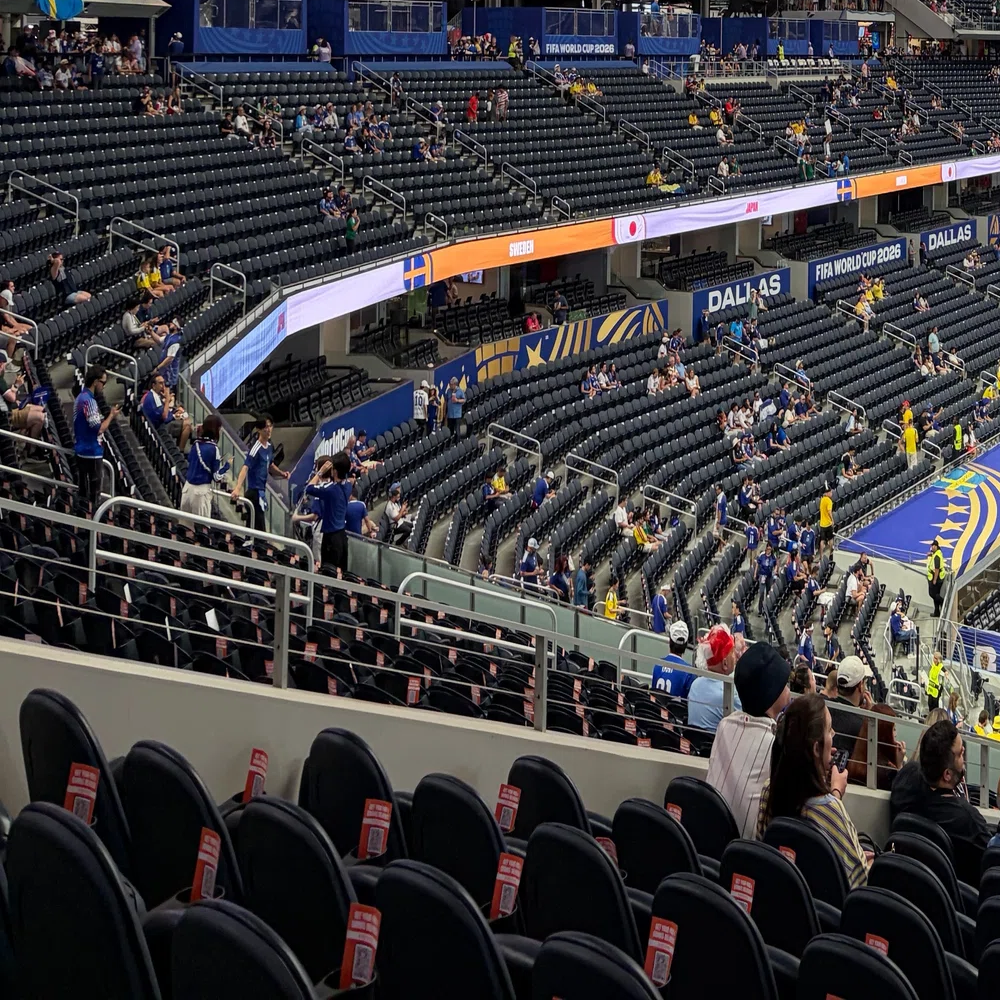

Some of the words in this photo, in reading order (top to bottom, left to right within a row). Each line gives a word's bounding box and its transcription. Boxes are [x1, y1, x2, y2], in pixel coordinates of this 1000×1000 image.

[546, 43, 559, 53] FIFA
[560, 43, 581, 53] WORLD
[582, 43, 594, 53] CUP
[595, 44, 614, 53] 2026
[509, 239, 535, 257] SWEDEN
[928, 224, 972, 251] DALLAS
[815, 262, 834, 281] FIFA
[834, 254, 862, 276] WORLD
[861, 251, 877, 268] CUP
[877, 243, 901, 264] 2026
[708, 274, 781, 313] DALLAS
[415, 395, 423, 406] 10
